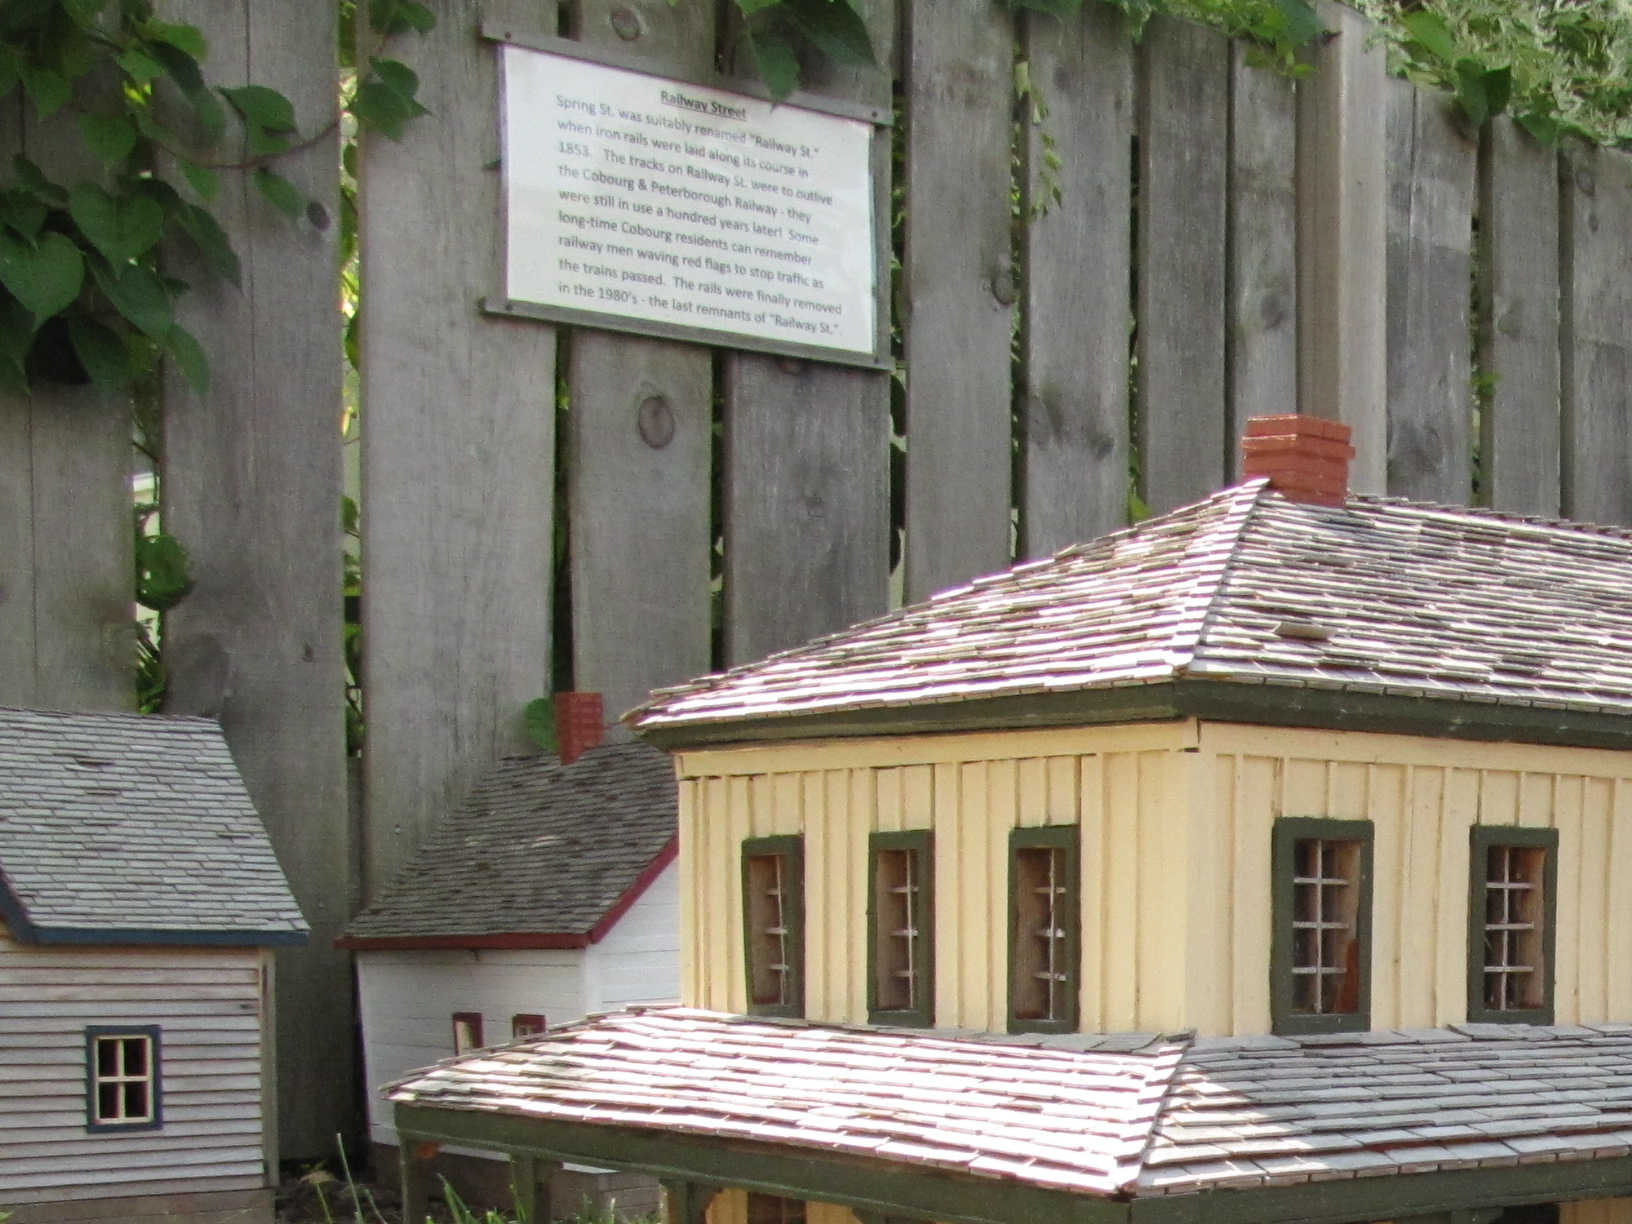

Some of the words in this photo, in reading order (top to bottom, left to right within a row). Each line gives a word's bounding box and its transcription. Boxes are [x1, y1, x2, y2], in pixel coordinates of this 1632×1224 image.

[556, 94, 596, 116] Spring
[618, 109, 643, 123] was
[645, 114, 692, 134] suitably
[694, 124, 746, 143] renamed
[661, 90, 708, 112] Railway
[708, 100, 746, 120] Street
[557, 119, 592, 135] when
[595, 125, 621, 140] iron
[623, 132, 648, 146] rails
[650, 138, 681, 153] were
[684, 142, 706, 158] laid
[708, 149, 740, 168] along
[742, 156, 757, 169] its
[758, 160, 796, 176] course
[797, 166, 809, 178] in
[557, 164, 579, 179] the
[582, 169, 635, 191] Cobourg
[637, 178, 647, 191] &
[650, 180, 732, 208] Peterborough
[734, 196, 777, 217] Railway
[786, 207, 811, 225] they
[602, 148, 626, 165] The
[628, 154, 665, 172] tracks
[667, 164, 683, 175] on
[685, 164, 730, 187] Railway
[750, 180, 779, 193] were
[780, 185, 794, 198] to
[795, 189, 833, 206] outlive
[557, 209, 618, 232] long-time
[620, 220, 672, 243] Cobourg
[675, 232, 728, 251] residents
[731, 242, 751, 254] can
[753, 246, 812, 265] remember
[558, 190, 590, 204] were
[593, 194, 615, 208] still
[617, 197, 629, 210] in
[632, 203, 653, 215] use
[655, 206, 664, 217] a
[665, 206, 717, 226] hundred
[719, 218, 750, 232] years
[752, 221, 782, 237] later!
[788, 228, 819, 245] Some
[558, 235, 603, 254] railway
[606, 243, 633, 256] men
[636, 249, 679, 267] waving
[681, 256, 702, 268] red
[704, 257, 731, 275] flags
[734, 263, 747, 275] to
[749, 267, 774, 282] stop
[776, 270, 809, 286] traffic
[812, 278, 824, 289] as
[558, 258, 580, 272] the
[582, 262, 618, 279] trains
[620, 270, 665, 286] passed.
[672, 275, 695, 291] The
[697, 282, 722, 295] rails
[724, 287, 754, 300] were
[756, 289, 791, 308] finally
[793, 298, 842, 315] removed
[557, 283, 570, 294] in
[573, 283, 595, 298] the
[598, 286, 638, 305] 1980's
[648, 295, 669, 309] the
[671, 298, 693, 313] last
[696, 304, 751, 322] remnants
[753, 311, 766, 323] of
